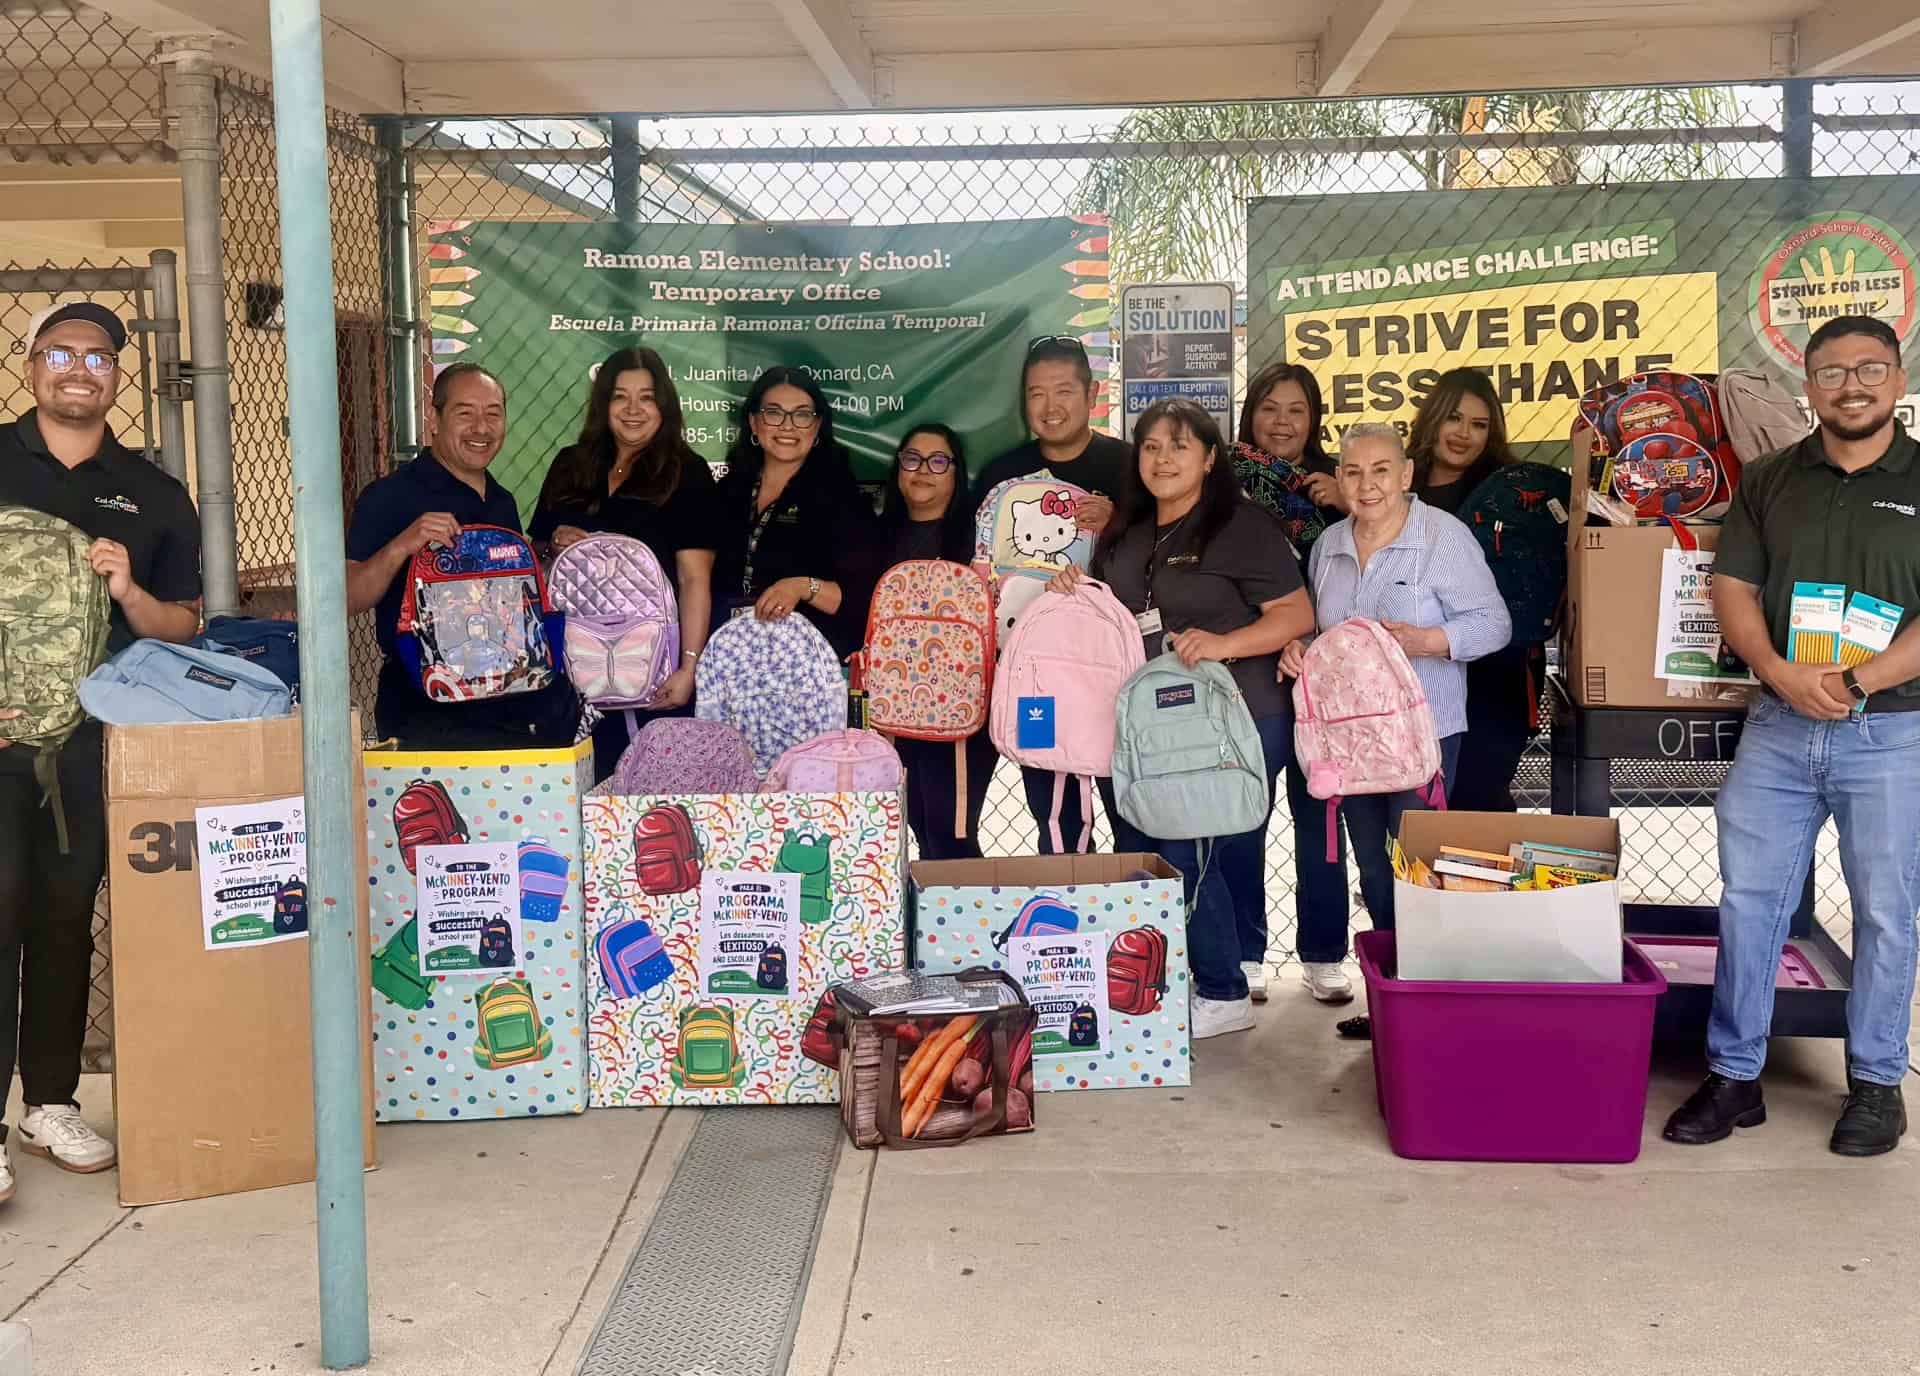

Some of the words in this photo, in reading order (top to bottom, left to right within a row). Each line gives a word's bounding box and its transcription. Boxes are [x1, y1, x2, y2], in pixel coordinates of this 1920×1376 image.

[1820, 222, 1860, 233] School
[583, 248, 692, 270] Ramona
[699, 250, 852, 278] Elementary
[860, 248, 952, 270] School:
[1277, 256, 1469, 301] ATTENDANCE
[1475, 234, 1659, 277] CHALLENGE:
[649, 281, 795, 306] Temporary
[801, 283, 882, 301] Office
[1771, 282, 1827, 300] STRIVE
[1831, 280, 1860, 295] FOR
[1865, 276, 1900, 291] LESS
[1128, 298, 1142, 310] BE
[1145, 297, 1165, 309] THE
[1798, 304, 1840, 320] THAN
[1844, 301, 1878, 317] FIVE
[550, 314, 625, 332] Escuela
[630, 315, 717, 332] Primaria
[722, 315, 809, 332] Ramona:
[815, 313, 887, 331] Oficina
[892, 312, 986, 331] Temporal
[1129, 309, 1226, 331] SOLUTION
[1294, 306, 1509, 361] STRIVE
[1523, 299, 1641, 346] FOR
[1184, 343, 1213, 352] REPORT
[1184, 352, 1227, 361] SUSPICIOUS
[1184, 361, 1217, 370] ACTIVITY
[684, 365, 747, 382] Juanita
[1179, 383, 1211, 393] REPORT
[680, 397, 736, 413] Hours:
[875, 396, 905, 412] PM
[488, 544, 519, 560] MARVEL
[1683, 621, 1720, 631] ¡EXITOS
[244, 826, 254, 834] TO
[255, 823, 269, 833] THE
[209, 831, 305, 855] McKINNEY-VENTO
[230, 847, 291, 865] PROGRAM
[1552, 867, 1598, 880] Crayola
[425, 873, 510, 889] McKINNEY-VENTO
[223, 882, 279, 900] successful
[442, 887, 496, 899] PROGRAM
[226, 900, 251, 910] school
[718, 894, 784, 909] PROGRAMA
[713, 909, 788, 922] McKINNEY-VENTO
[435, 919, 484, 930] successful
[437, 933, 460, 941] school
[720, 931, 732, 939] Les
[733, 931, 764, 939] deseamos
[723, 941, 763, 952] ¡EXITOSO
[712, 955, 725, 963] AÑO
[727, 955, 757, 963] ESCOLAR!
[1026, 957, 1092, 972] PROGRAMA
[1022, 971, 1096, 985] McKINNEY-VENTO
[1030, 994, 1042, 1002] Les
[1043, 993, 1073, 1001] deseamos
